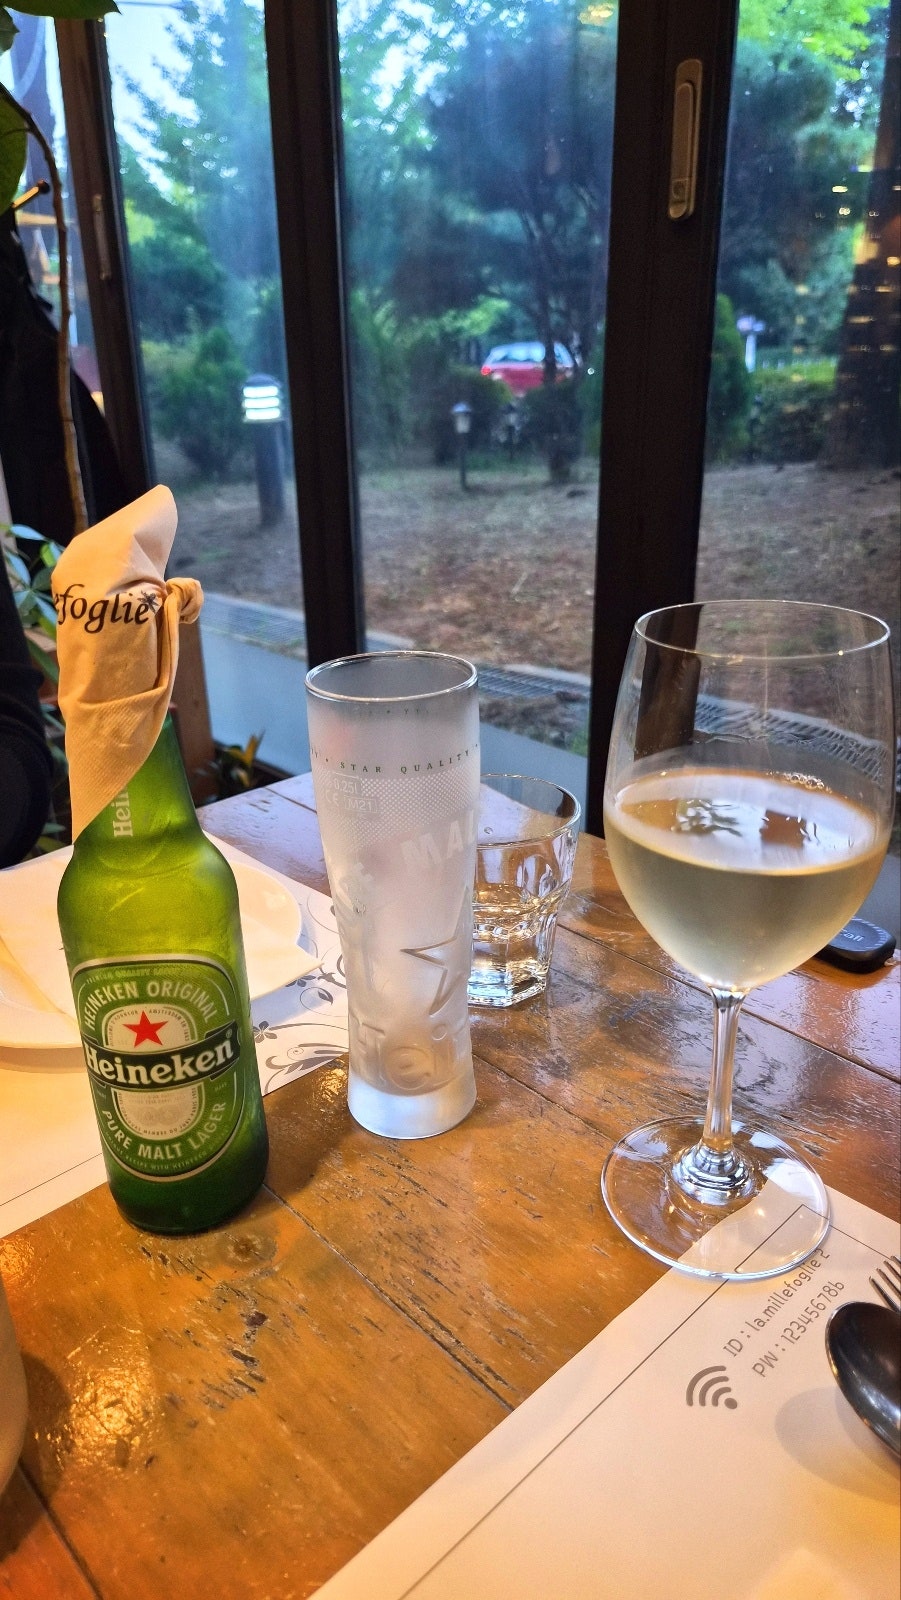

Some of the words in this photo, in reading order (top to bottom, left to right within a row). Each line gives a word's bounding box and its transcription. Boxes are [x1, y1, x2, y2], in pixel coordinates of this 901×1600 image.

[340, 761, 382, 774] STAR
[400, 750, 470, 775] QUALITY
[84, 981, 139, 1031] HEINEKEN
[146, 980, 218, 1024] ORIGINAL
[84, 1038, 234, 1085] Heineken
[102, 1110, 133, 1150] PURE
[138, 1143, 183, 1160] MALT
[187, 1102, 227, 1150] LAGER
[723, 1338, 744, 1358] ID
[752, 1351, 779, 1378] PW
